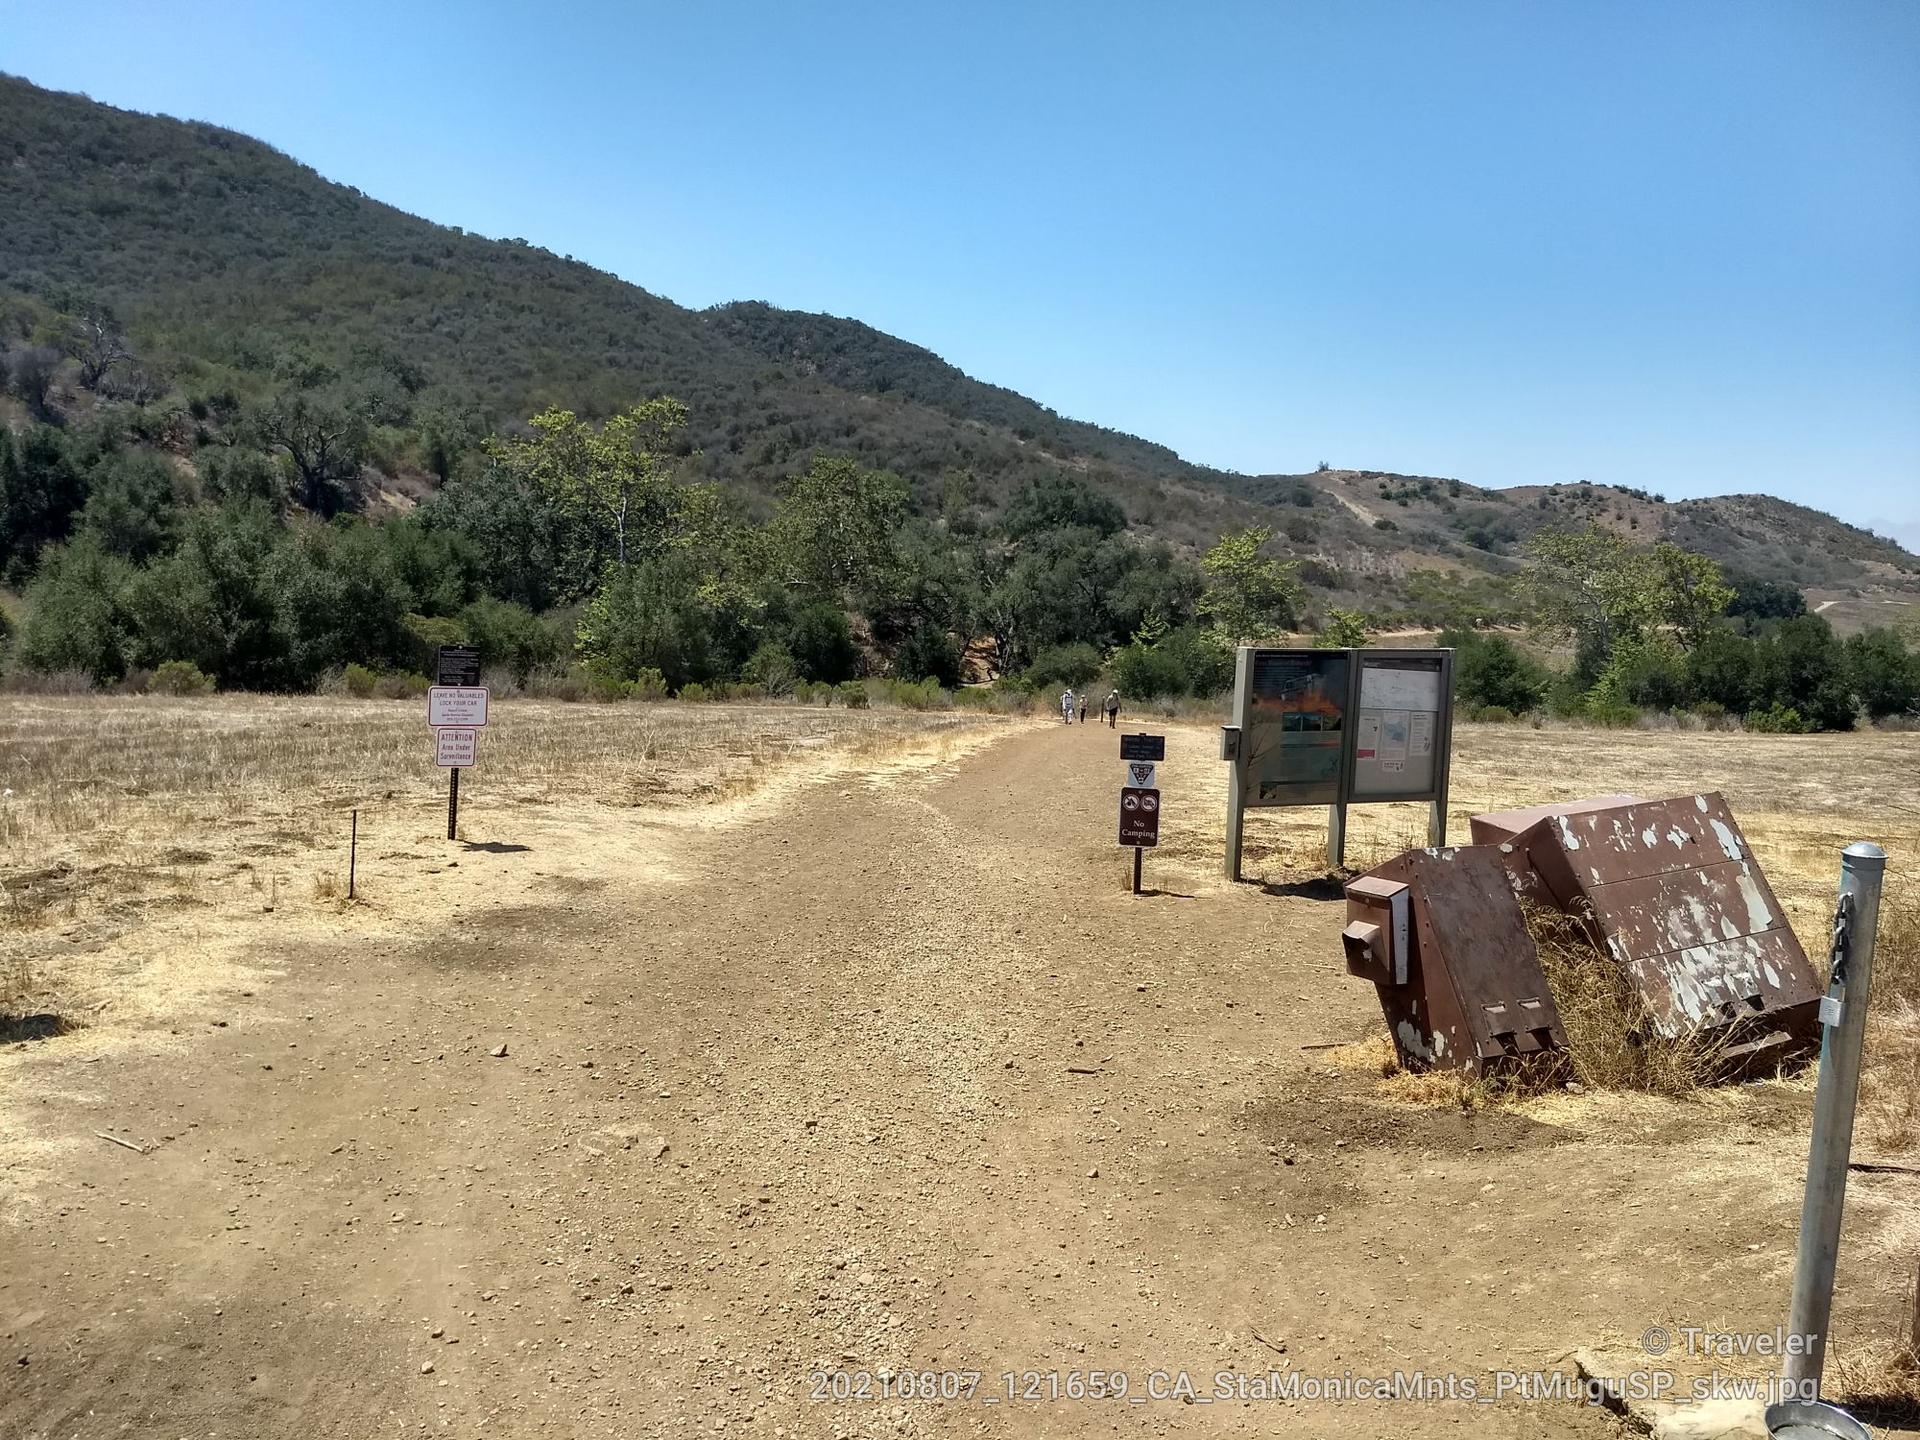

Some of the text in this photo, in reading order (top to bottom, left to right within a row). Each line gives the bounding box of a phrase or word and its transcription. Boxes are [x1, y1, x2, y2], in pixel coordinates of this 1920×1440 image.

[441, 733, 473, 742] ATTENTION
[442, 743, 471, 751] Area Under
[440, 752, 471, 760] Surveillance
[1133, 820, 1145, 828] No
[1121, 829, 1156, 839] Camping
